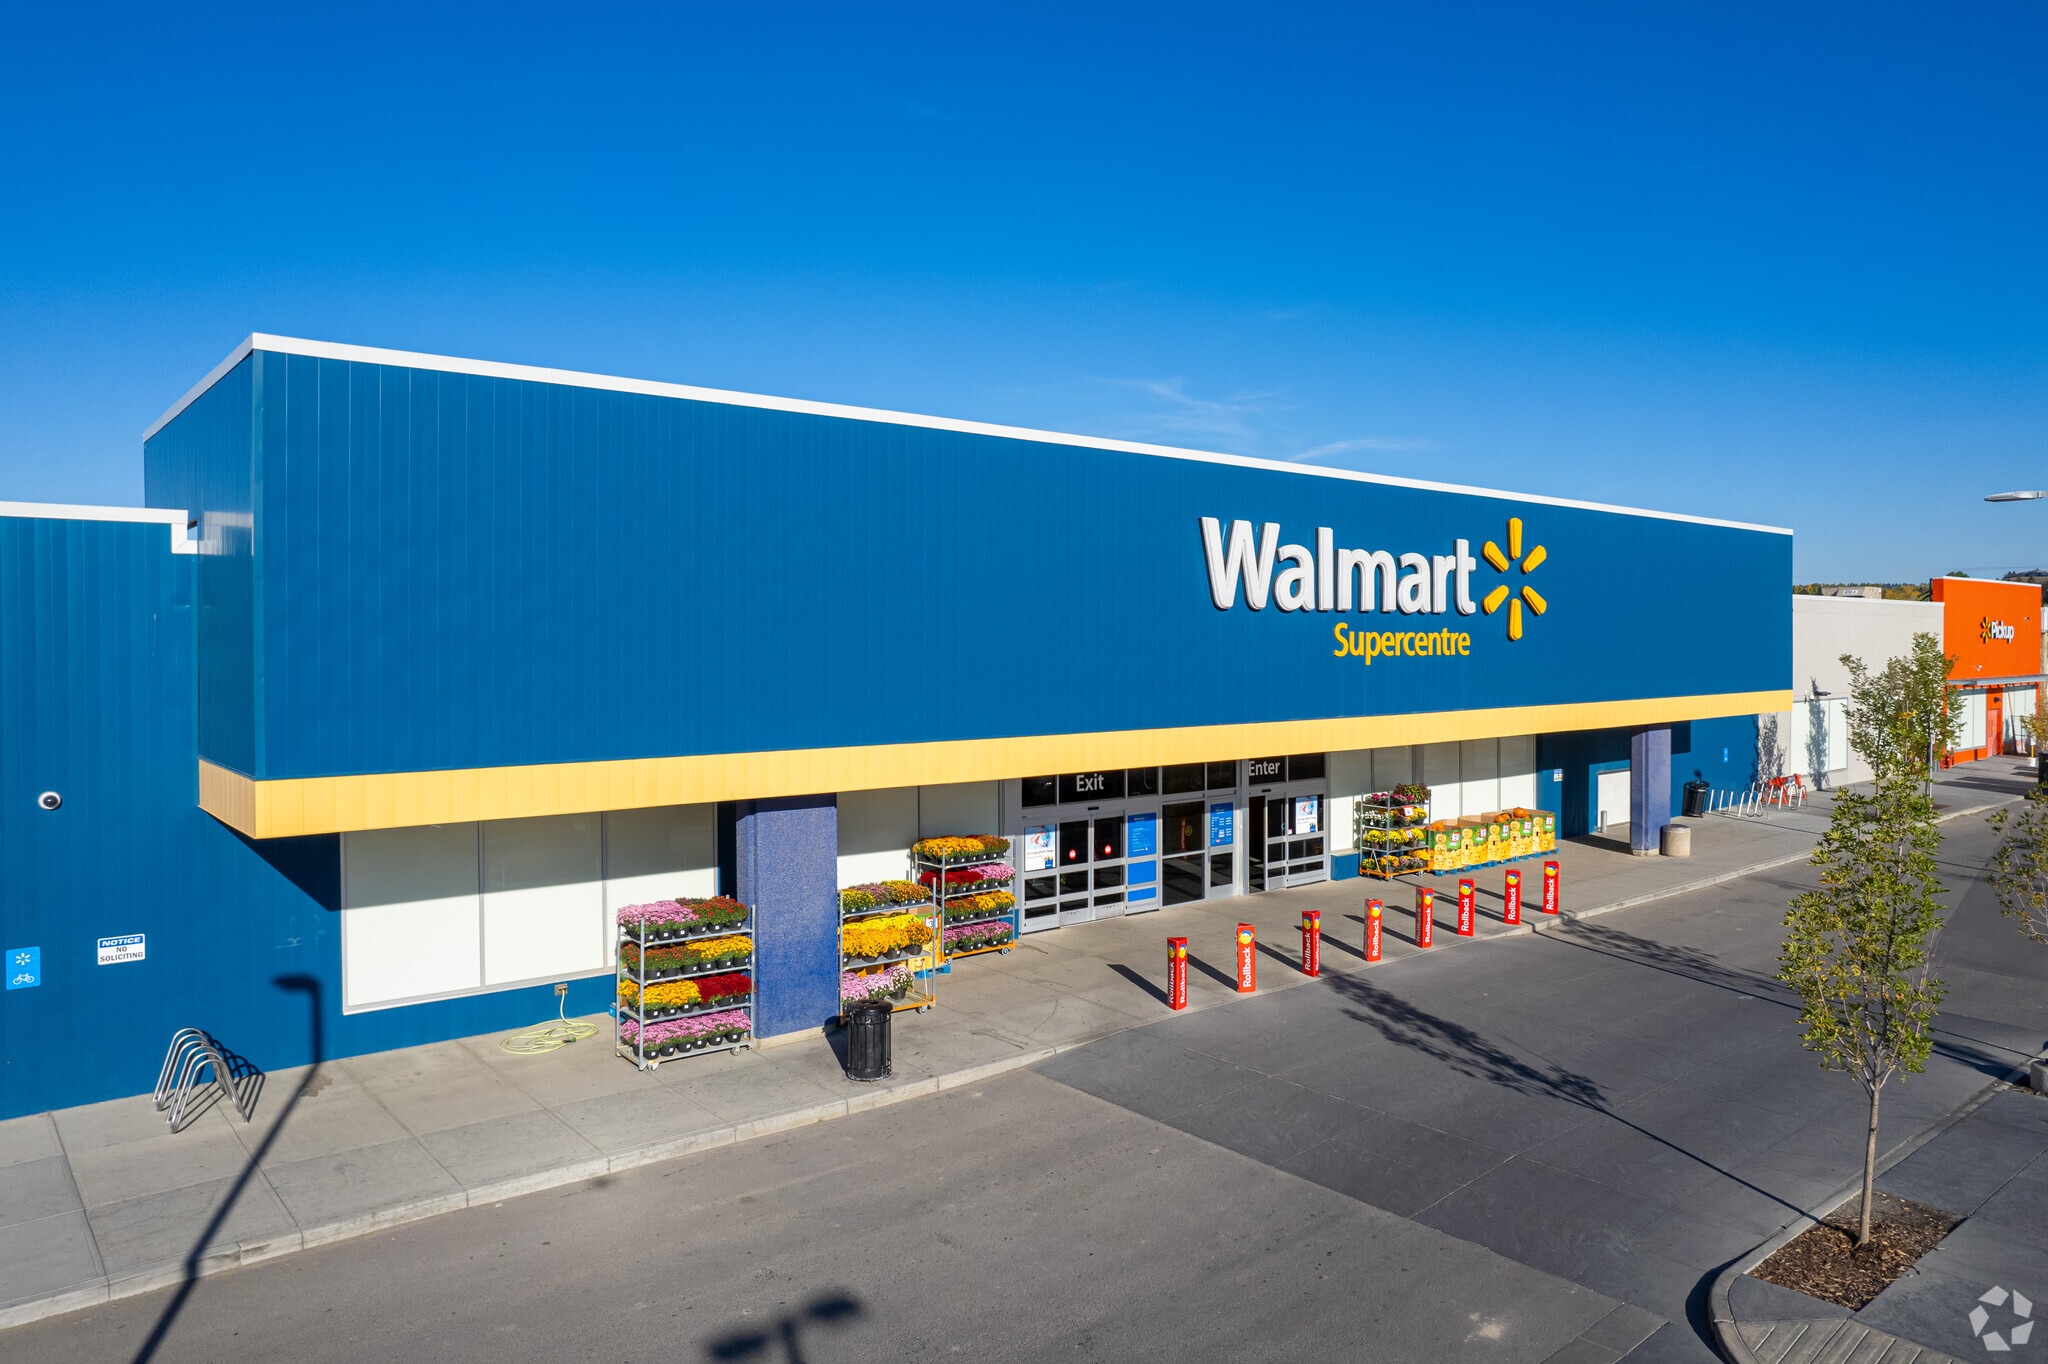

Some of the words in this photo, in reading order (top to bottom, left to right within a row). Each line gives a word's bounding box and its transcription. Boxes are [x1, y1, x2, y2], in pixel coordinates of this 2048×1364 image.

[1200, 516, 1476, 615] Walmart
[1333, 622, 1471, 666] Supercentre
[1991, 620, 2014, 643] Pickup
[1076, 772, 1104, 792] Exit
[1248, 761, 1281, 777] Enter
[1508, 887, 1516, 920] Rollback
[1546, 878, 1554, 910] Rollback
[1461, 897, 1470, 932] Rollback
[100, 952, 143, 962] SOLICITING
[102, 936, 141, 946] NOTICE
[1242, 946, 1251, 988] Rollback
